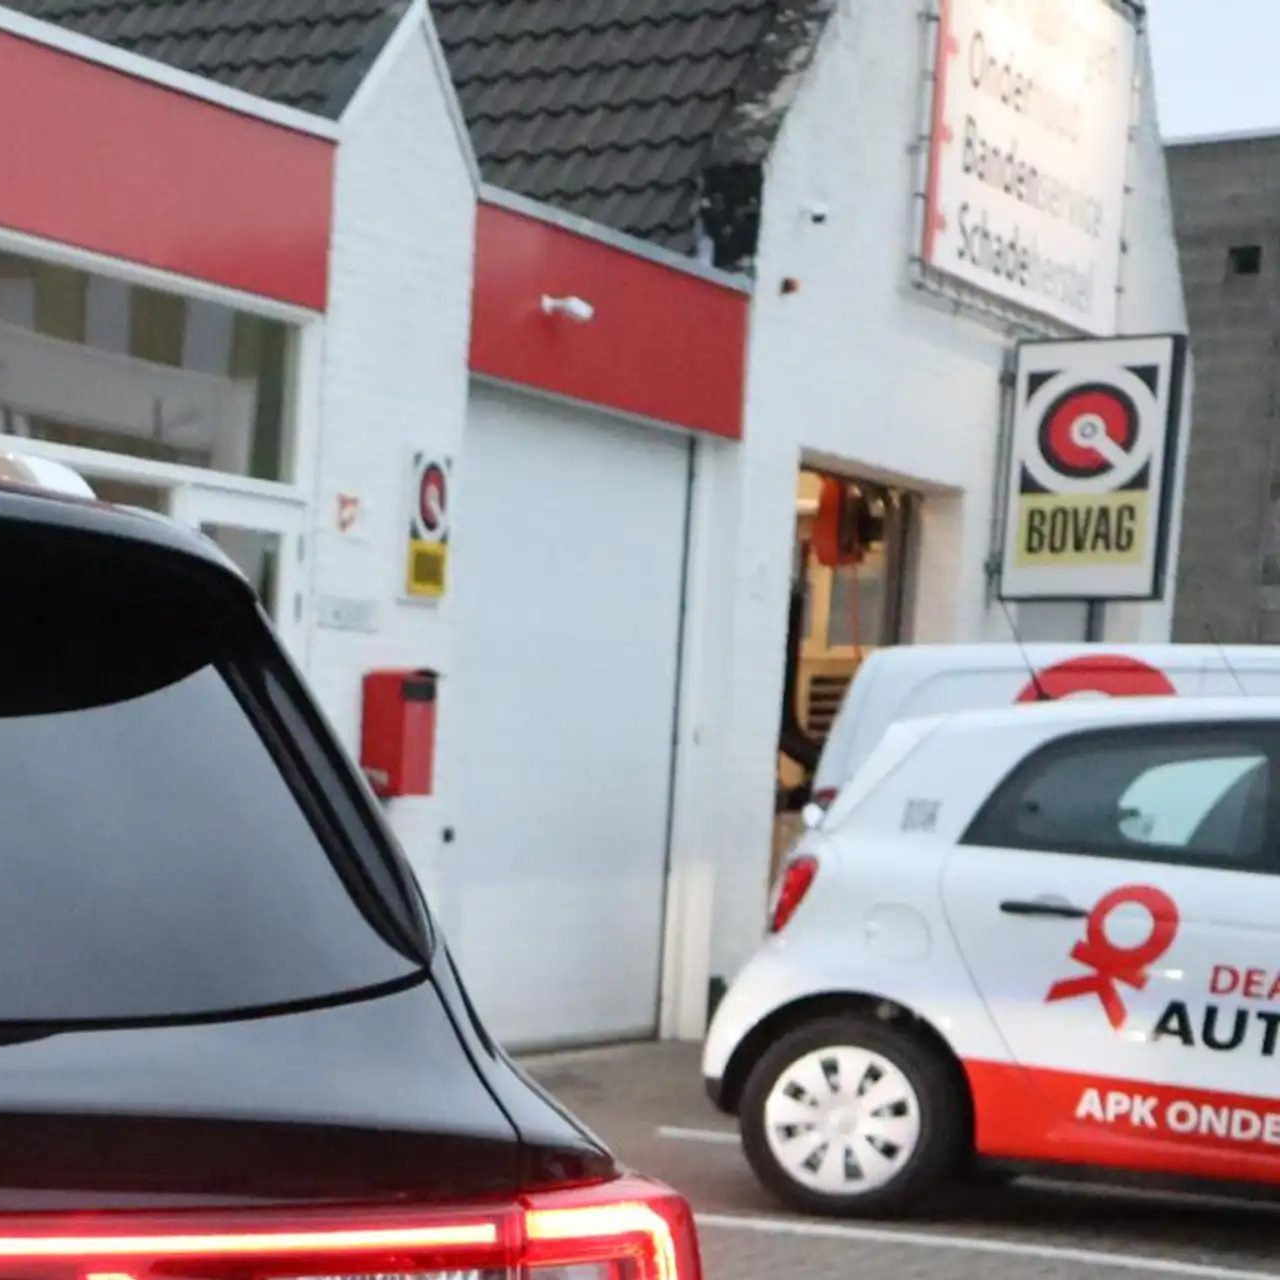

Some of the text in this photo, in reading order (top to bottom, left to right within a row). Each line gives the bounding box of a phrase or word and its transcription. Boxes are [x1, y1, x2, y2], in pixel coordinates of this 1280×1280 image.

[968, 29, 1080, 144] Onderd
[1025, 503, 1137, 555] BOVAG
[1075, 1087, 1159, 1129] APK
